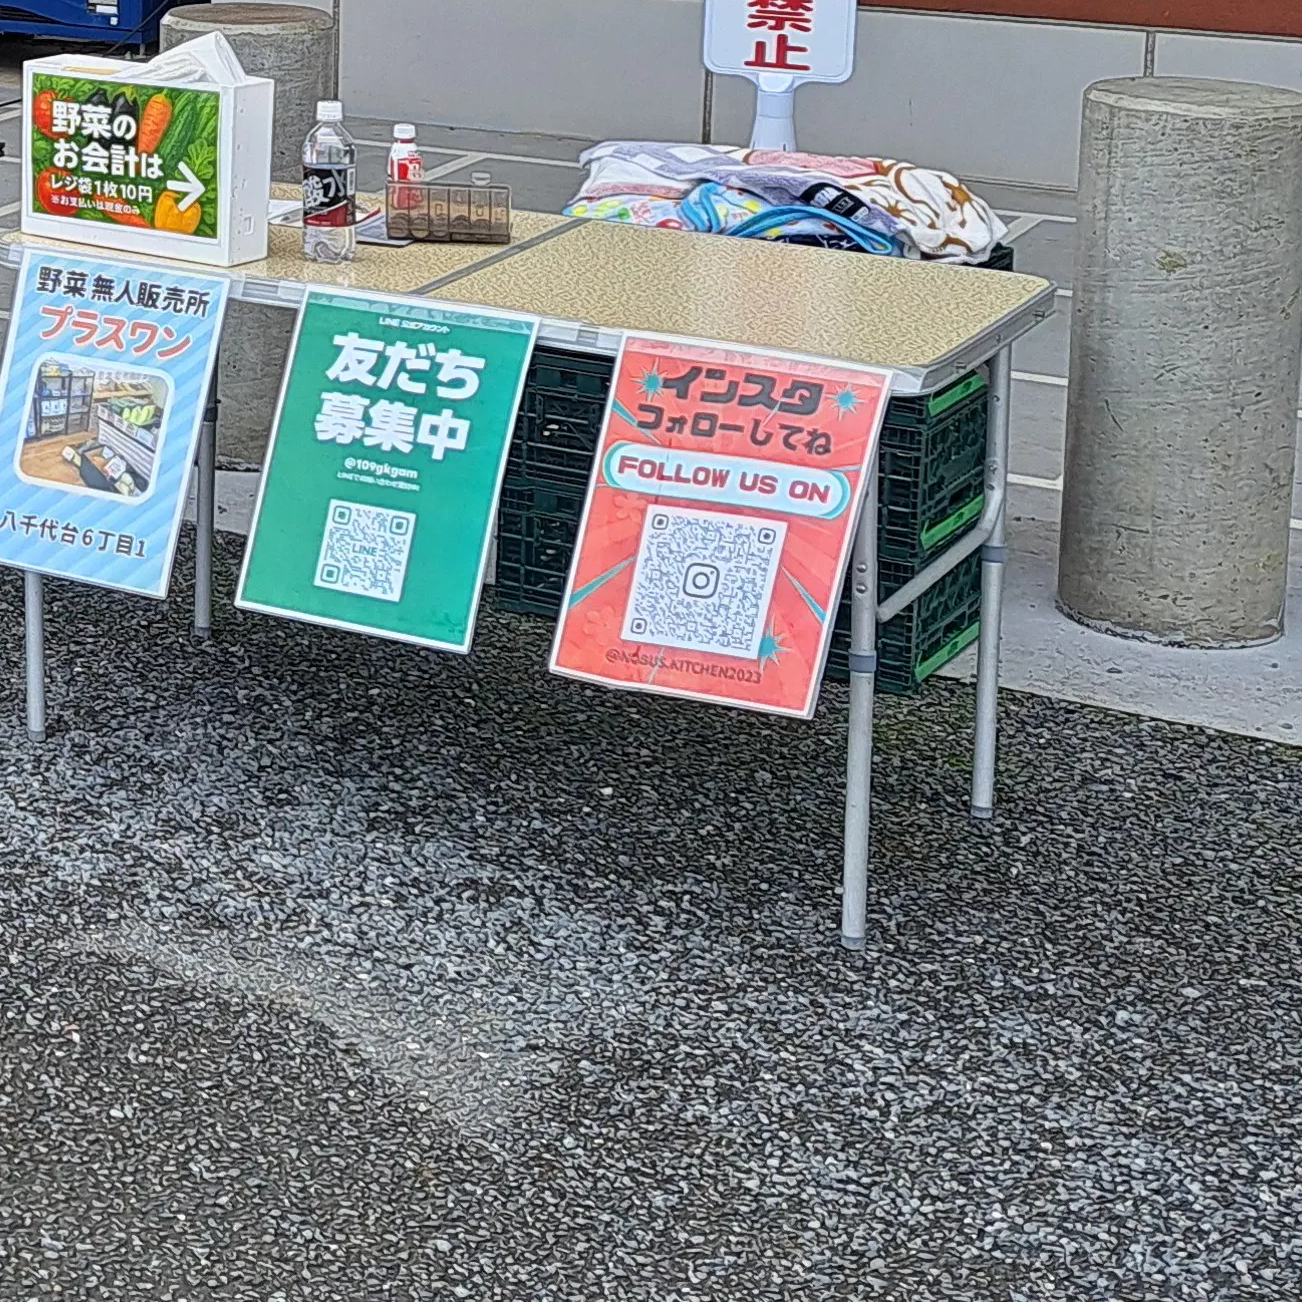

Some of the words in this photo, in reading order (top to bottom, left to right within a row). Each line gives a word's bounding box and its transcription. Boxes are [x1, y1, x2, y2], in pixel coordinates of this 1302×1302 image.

[51, 100, 138, 141] 野菜の
[52, 138, 165, 180] お会計は
[36, 266, 89, 298] 野菜
[90, 275, 211, 318] 無人販売所
[38, 305, 192, 359] プラスワン
[379, 316, 400, 327] LINE
[325, 332, 486, 399] 友だち
[661, 365, 824, 415] インスタ
[313, 391, 471, 461] 募集中
[636, 403, 833, 456] フォローしてね
[344, 457, 419, 479] @109gkgam
[617, 455, 731, 489] FOLLOW
[739, 471, 779, 496] US
[788, 479, 832, 505] ON
[352, 541, 379, 557] LINE
